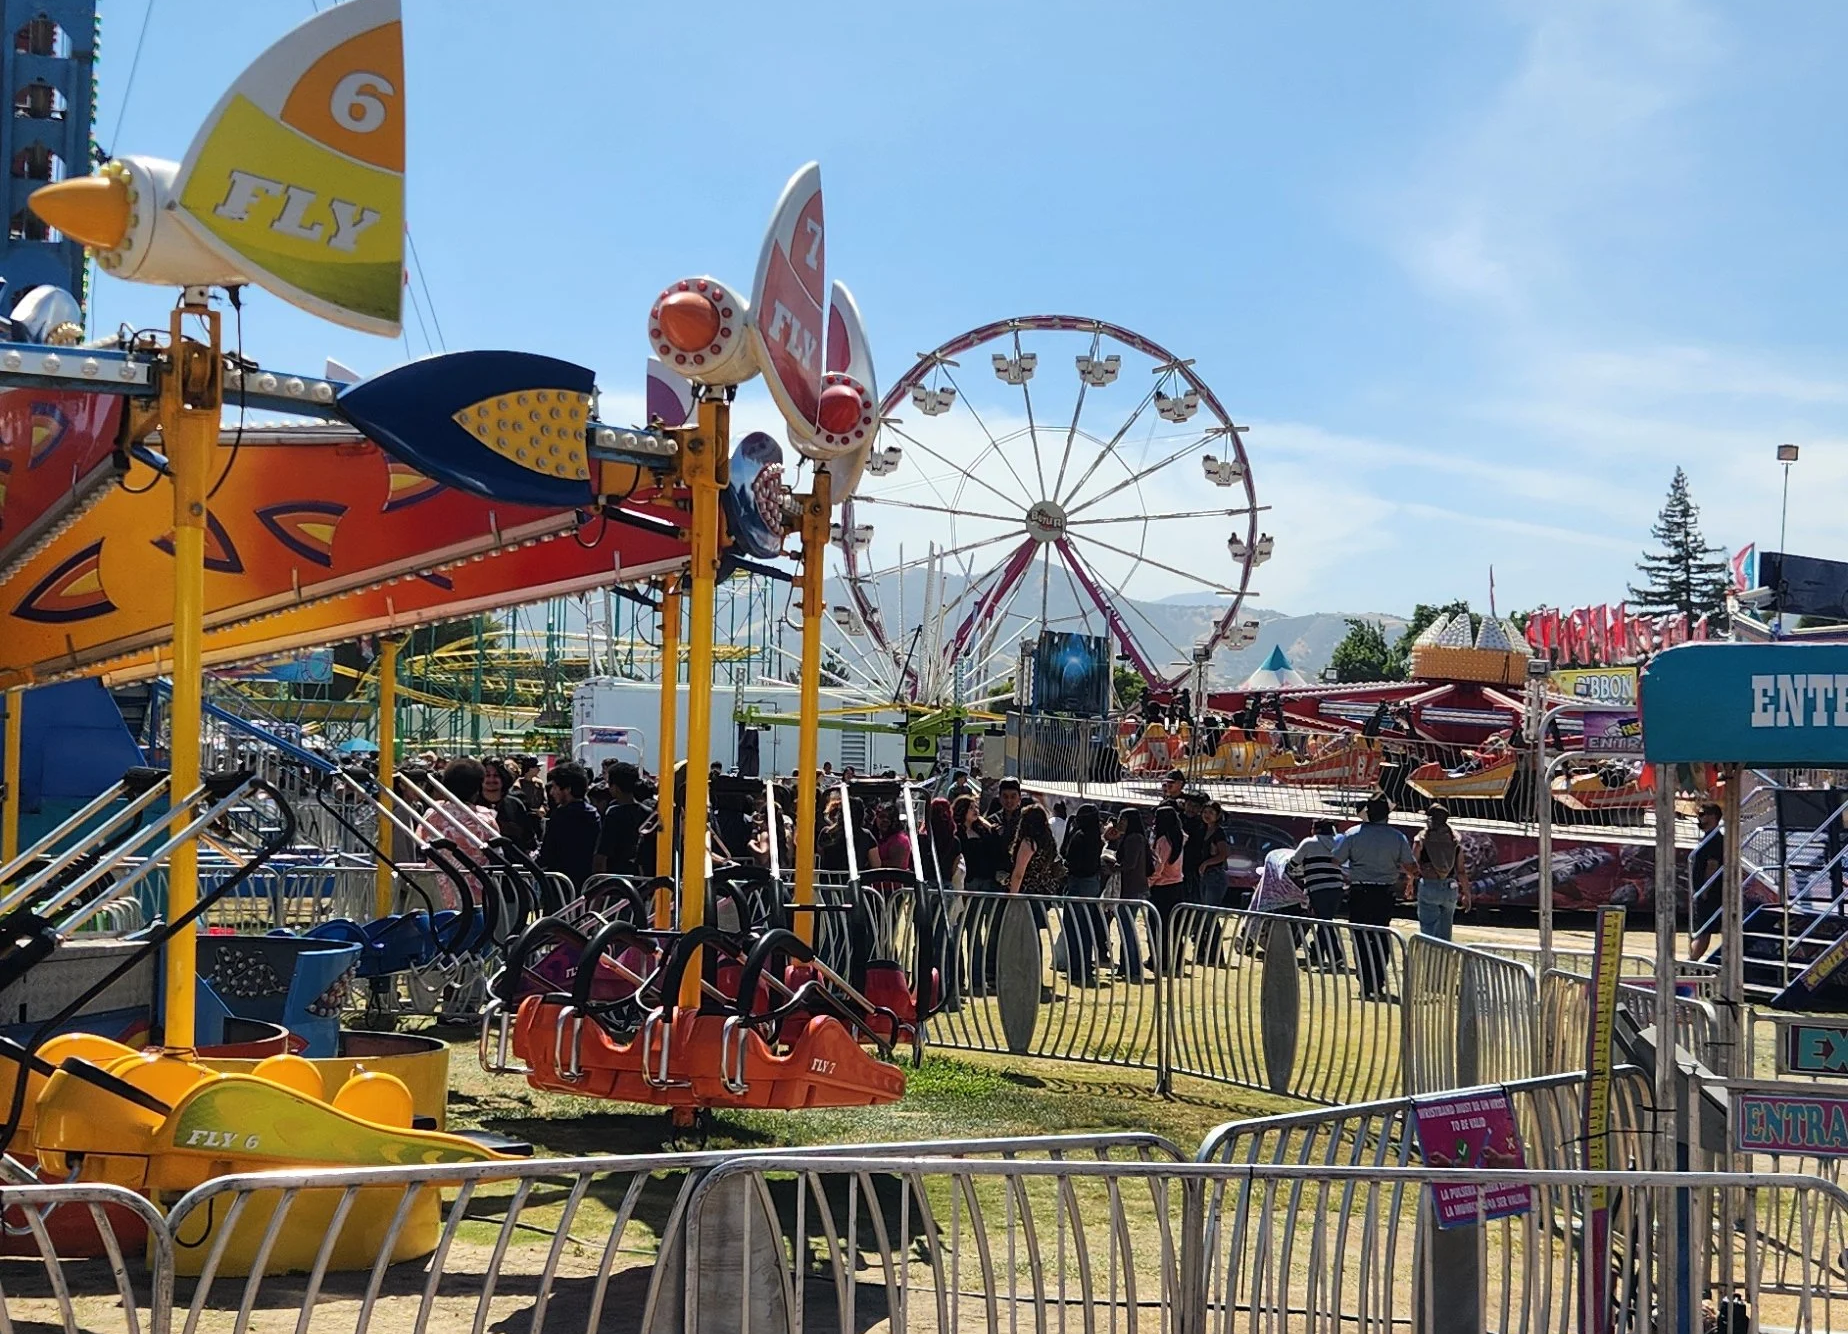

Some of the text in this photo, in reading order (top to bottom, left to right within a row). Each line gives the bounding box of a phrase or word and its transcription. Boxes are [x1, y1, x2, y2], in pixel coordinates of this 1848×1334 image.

[330, 72, 395, 133] 6
[213, 169, 380, 253] FLY
[806, 217, 822, 270] 7
[768, 298, 817, 370] FLY
[1751, 674, 1848, 727] ENTE
[1588, 737, 1644, 748] ENTR
[811, 1058, 837, 1074] FLY 7
[186, 1129, 260, 1150] FLY 6
[1451, 1119, 1461, 1131] TO
[1743, 1101, 1848, 1147] ENTRA
[1454, 1200, 1477, 1216] MUÑEC
